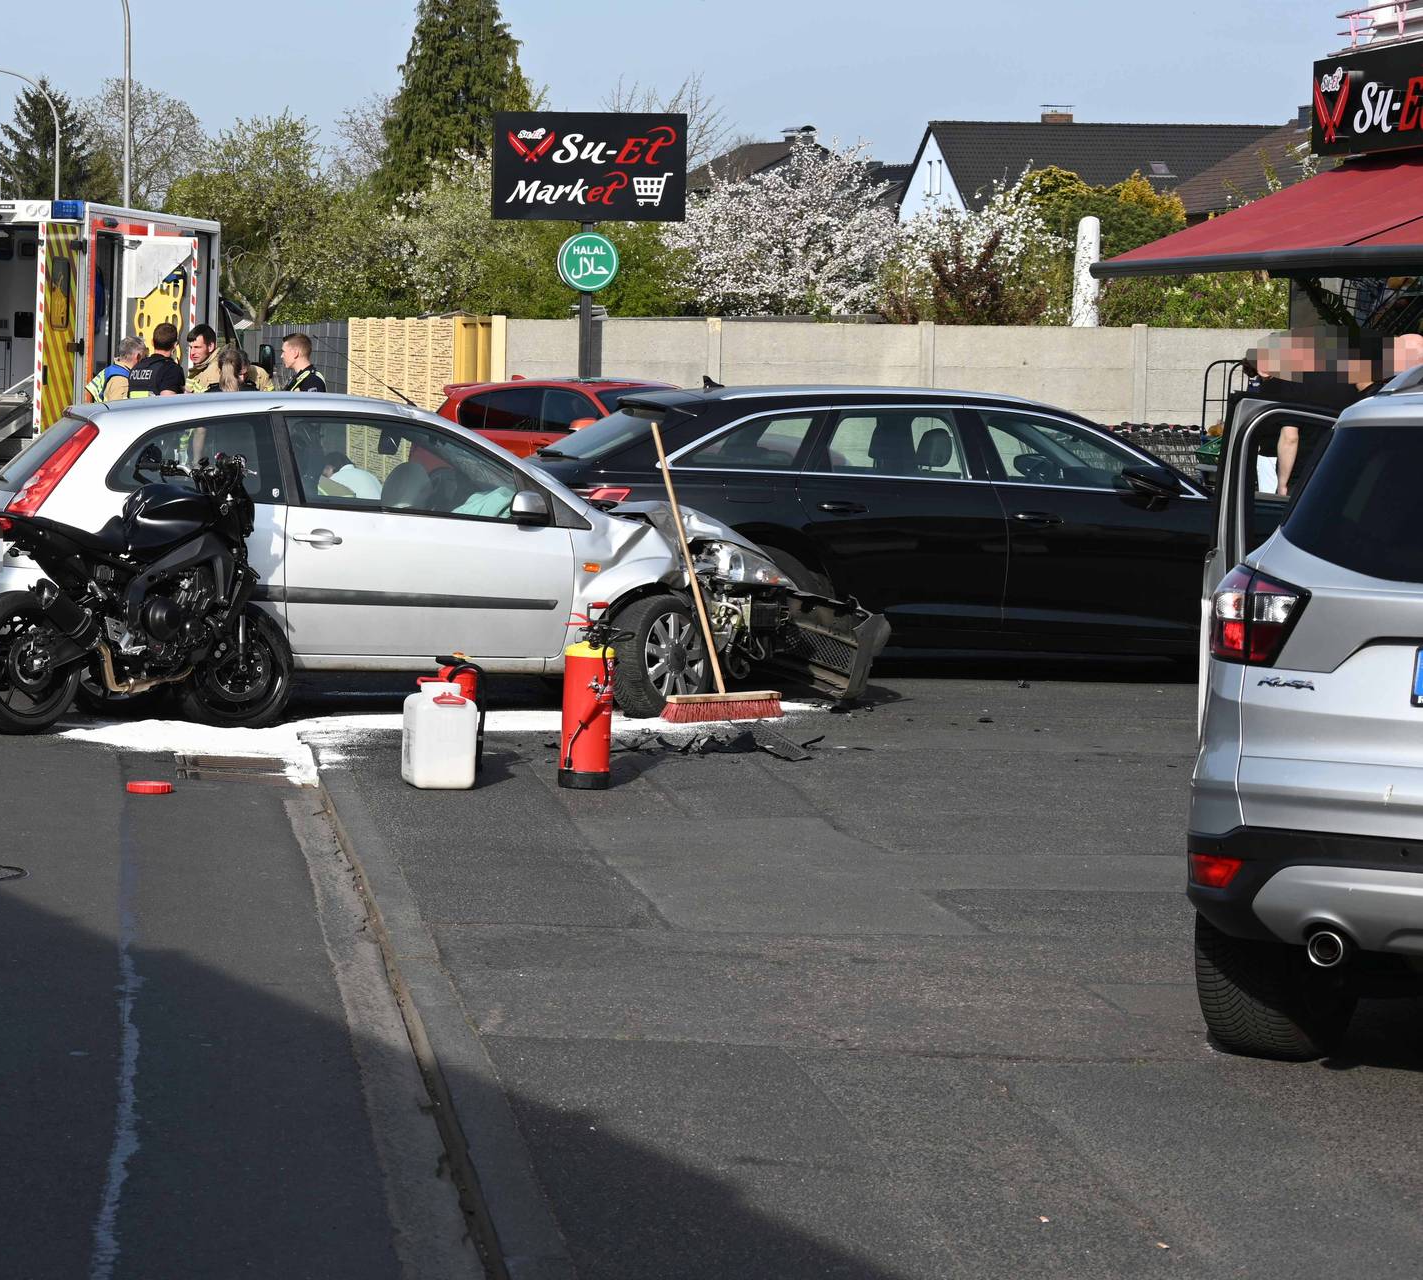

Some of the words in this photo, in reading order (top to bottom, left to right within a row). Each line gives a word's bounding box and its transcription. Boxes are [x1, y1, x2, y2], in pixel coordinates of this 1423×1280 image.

[552, 126, 677, 165] Su-Et
[505, 172, 628, 206] Market
[573, 246, 606, 255] HALAL
[571, 258, 609, 279] حلال
[129, 369, 153, 380] POLIZEI
